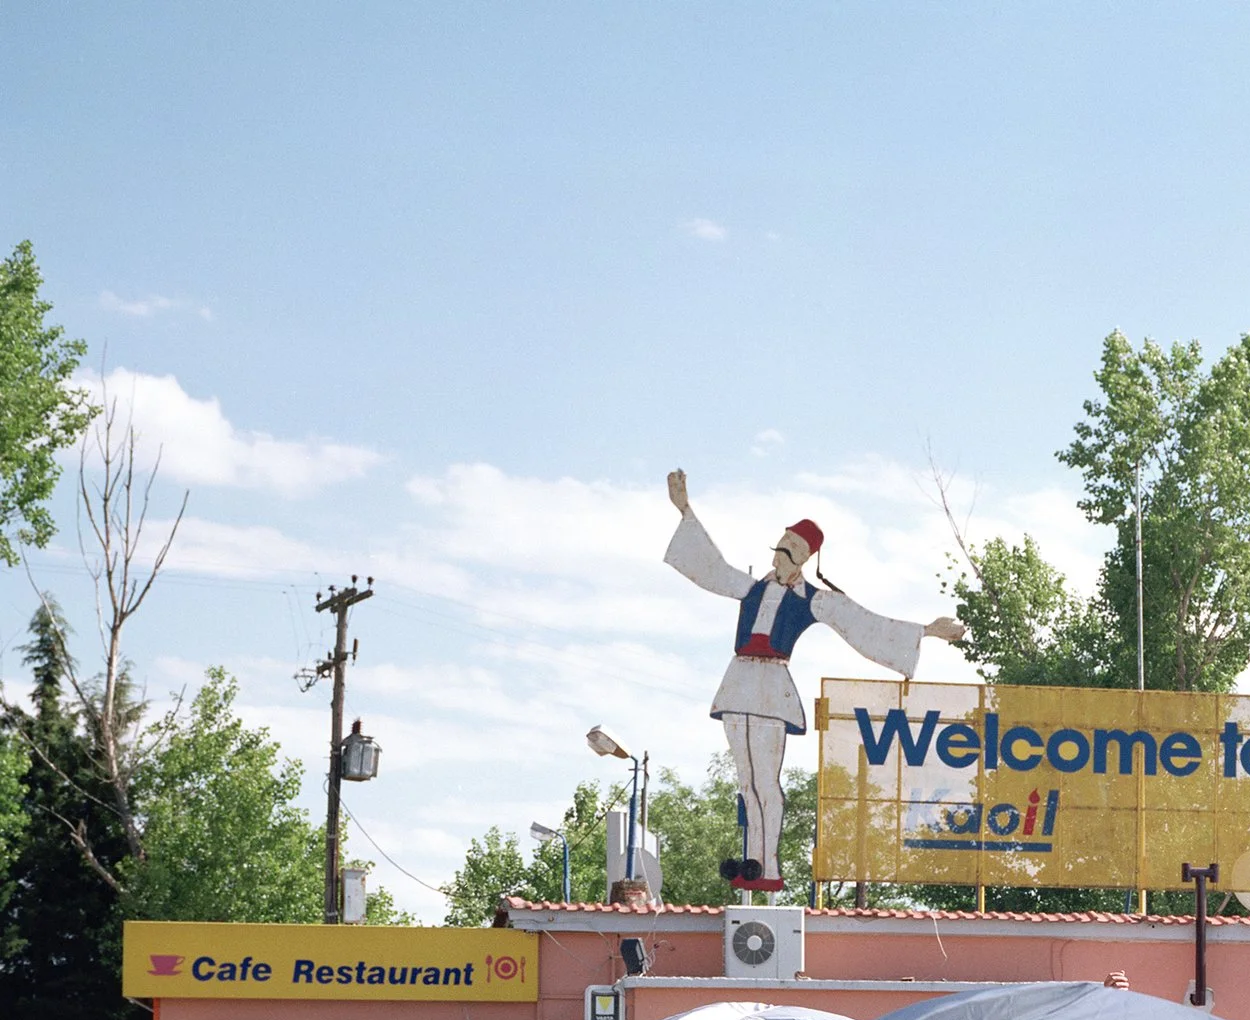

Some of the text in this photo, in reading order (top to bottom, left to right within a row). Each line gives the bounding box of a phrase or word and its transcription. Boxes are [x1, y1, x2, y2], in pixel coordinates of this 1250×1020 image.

[853, 707, 1203, 777] Welcome
[192, 956, 475, 986] Cafe Restaurant
